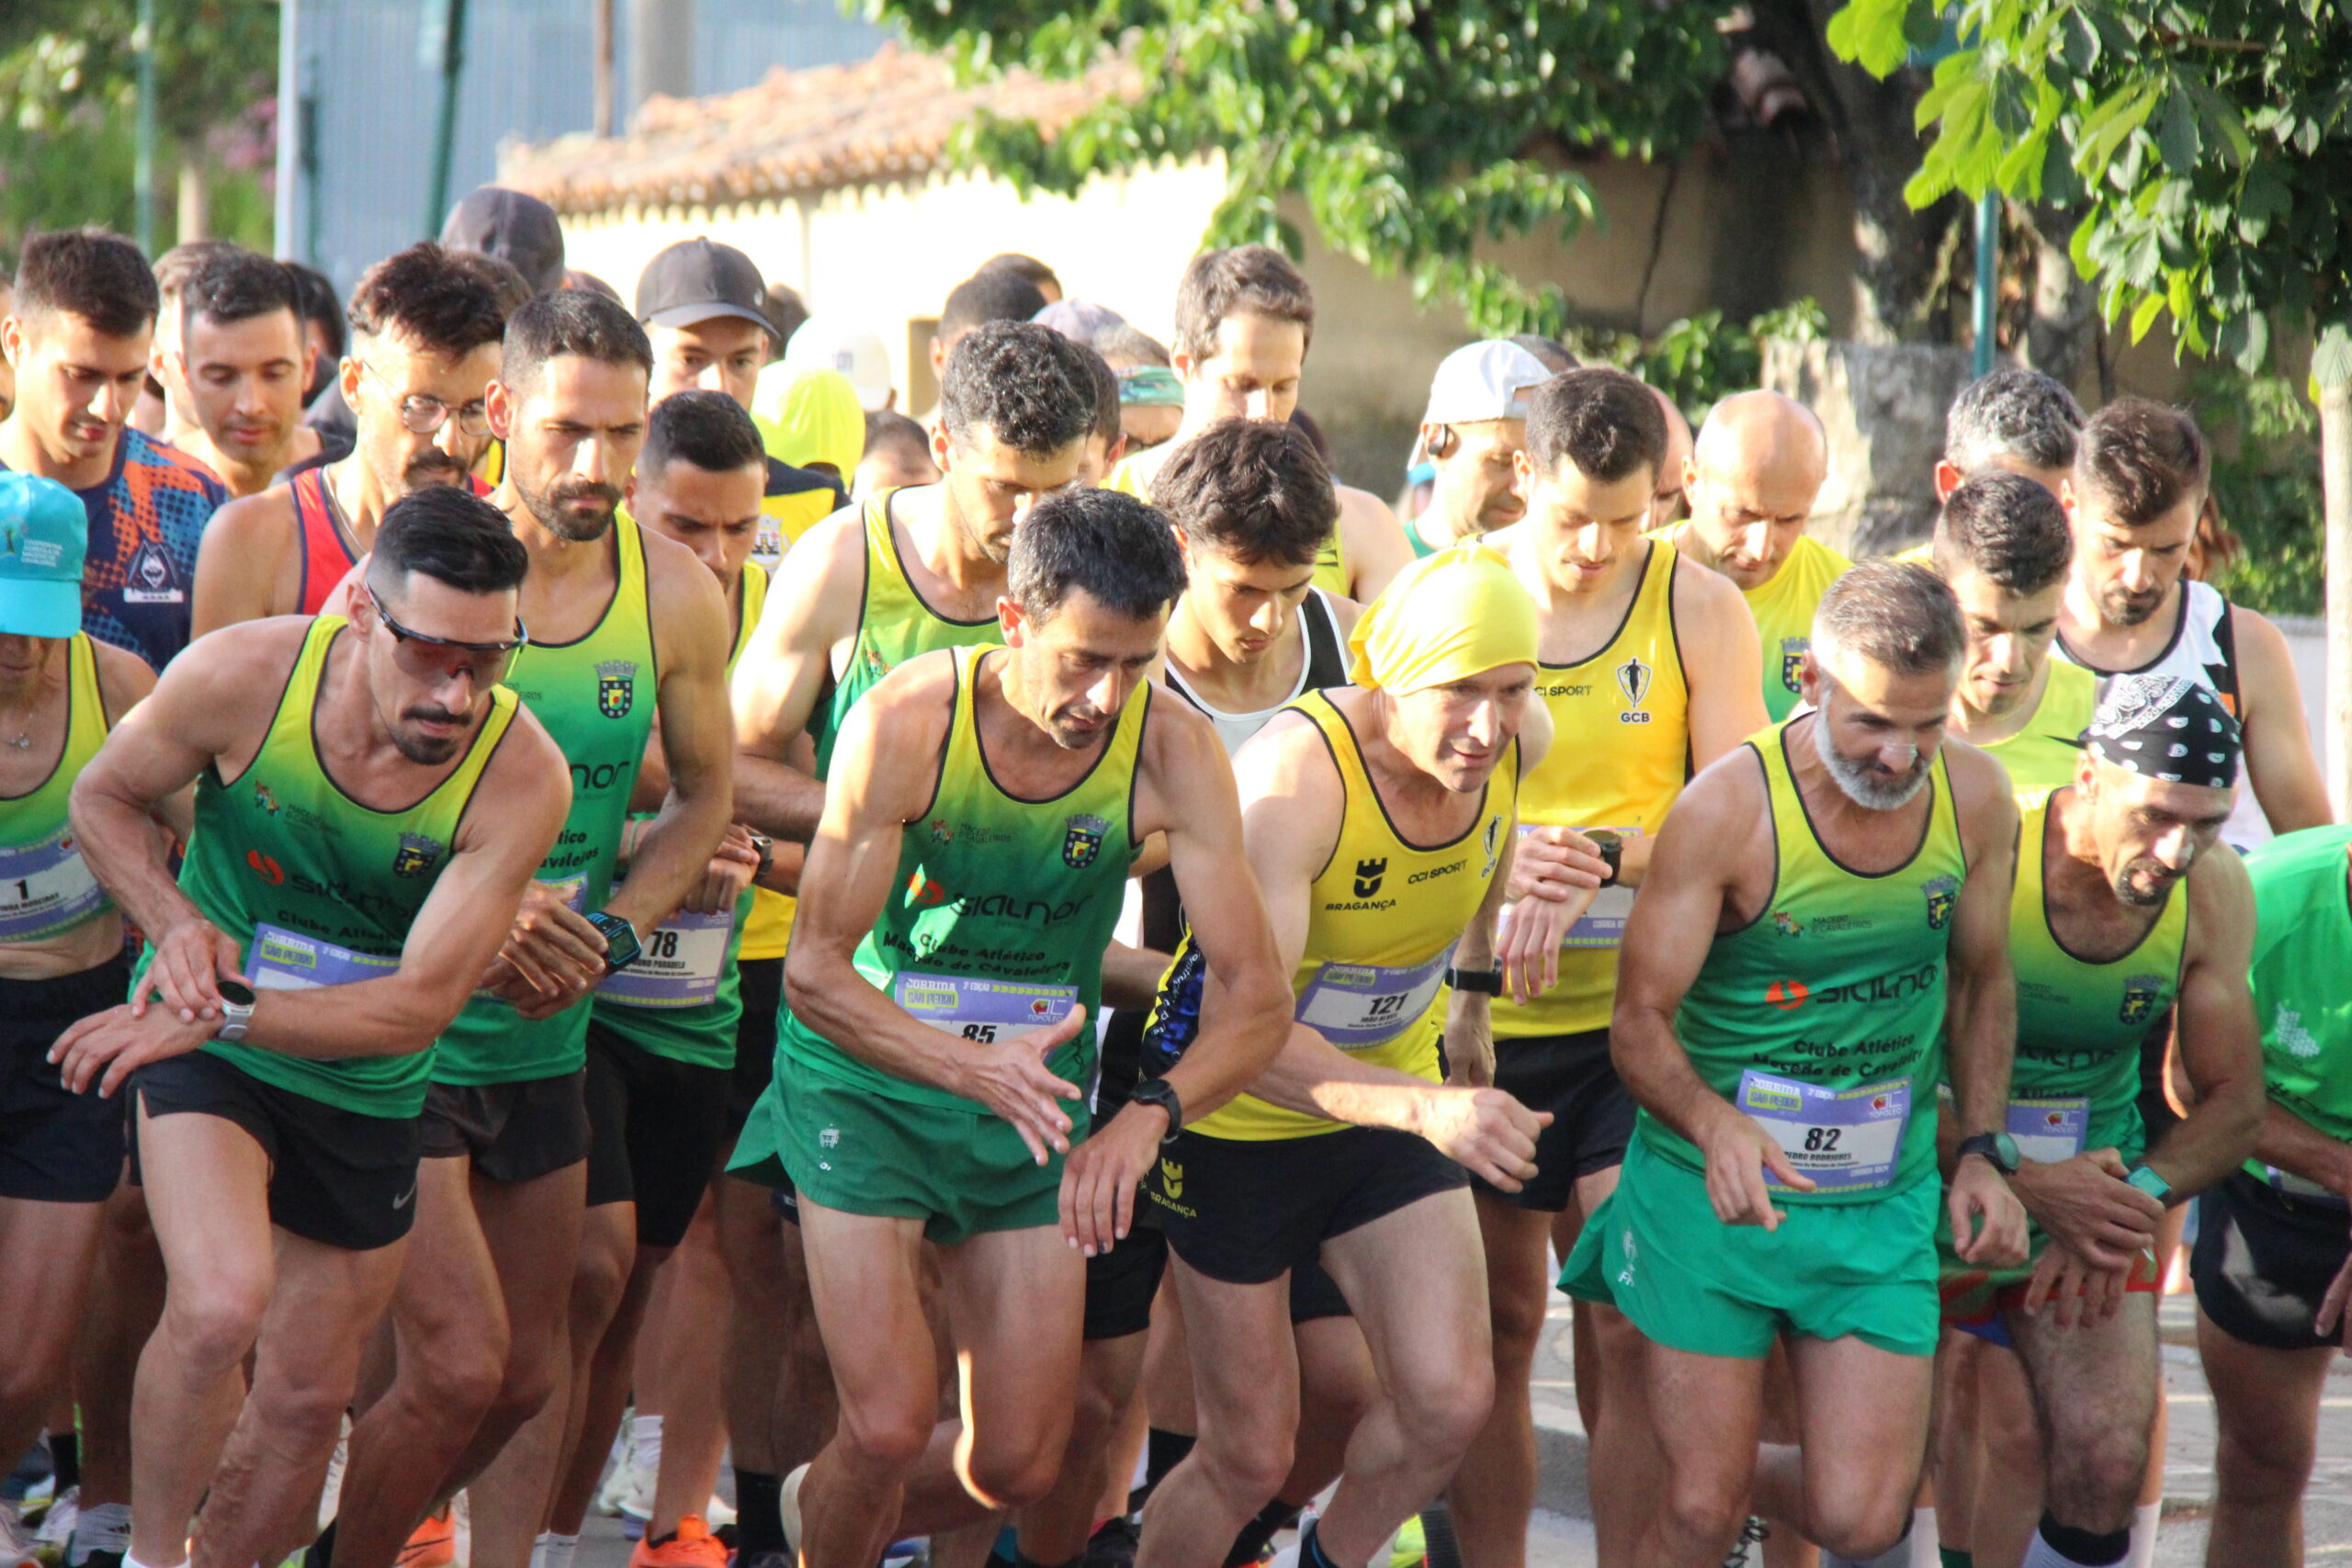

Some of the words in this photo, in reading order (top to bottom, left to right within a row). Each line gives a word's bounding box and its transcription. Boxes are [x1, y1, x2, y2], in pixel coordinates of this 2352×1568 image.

[1549, 685, 1592, 696] SPORT
[1621, 712, 1650, 723] GCB
[1408, 872, 1429, 885] CCI
[1430, 859, 1469, 878] SPORT
[14, 879, 28, 899] 1
[1325, 898, 1396, 911] BRAGANÇA
[277, 909, 331, 933] Clube
[650, 931, 679, 958] 78
[920, 932, 969, 957] Clube
[975, 948, 1046, 962] Atlético
[949, 959, 971, 971] de
[906, 978, 956, 992] CORRIDA
[1369, 992, 1408, 1016] 121
[961, 1024, 998, 1043] 85
[1793, 1040, 1849, 1058] Clube
[1829, 1065, 1852, 1077] de
[1750, 1077, 1802, 1097] CORRIDA
[1869, 1108, 1904, 1119] TOPOLEO
[1804, 1127, 1842, 1152] 82
[1810, 1152, 1853, 1162] RODRIGUES
[1149, 1190, 1197, 1219] BRAGANÇA
